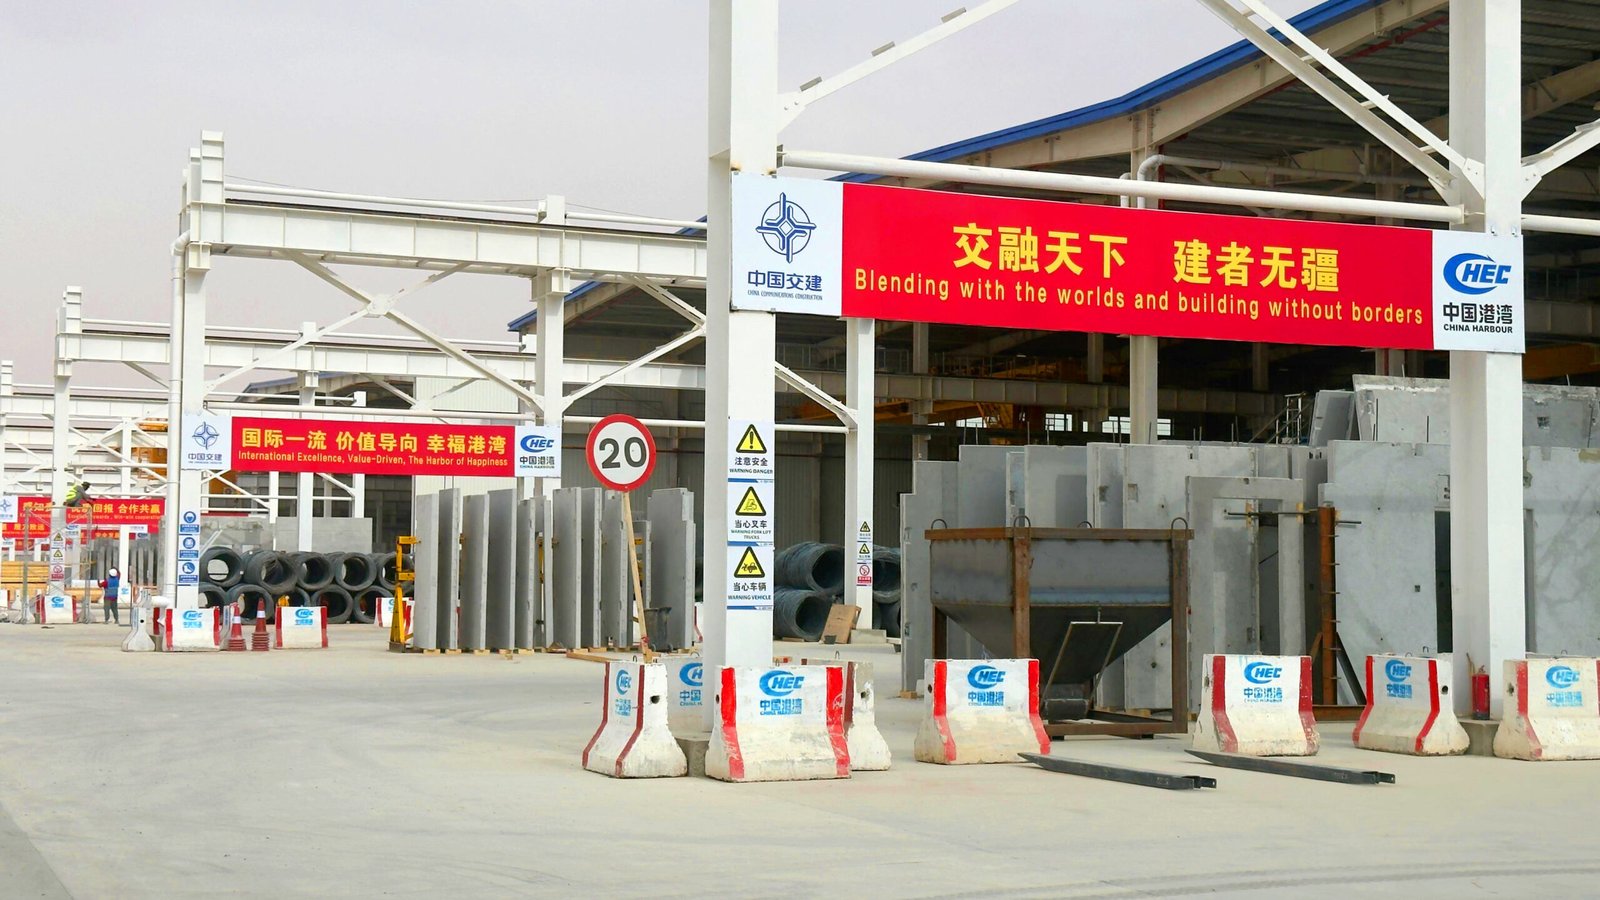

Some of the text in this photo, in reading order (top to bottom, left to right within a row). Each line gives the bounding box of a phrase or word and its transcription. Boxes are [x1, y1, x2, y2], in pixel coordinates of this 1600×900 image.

[953, 222, 1340, 292] 交融天下 建者无疆
[747, 269, 823, 292] 中国交建
[855, 267, 1423, 325] Blending with the worlds and building without borders
[1442, 302, 1513, 325] 中国港湾
[1443, 323, 1514, 334] CHINA HARBOUR
[241, 427, 507, 455] 国际一流 价值导向 幸福港湾
[187, 453, 223, 461] 中国交建
[238, 450, 508, 468] International Excellence, Value-Driven, The Harbor of Happiness
[519, 455, 555, 465] 中国港湾
[598, 436, 648, 469] 20
[735, 456, 768, 467] 注意安全
[735, 519, 768, 529] 当心叉车
[733, 582, 767, 592] 当心车辆
